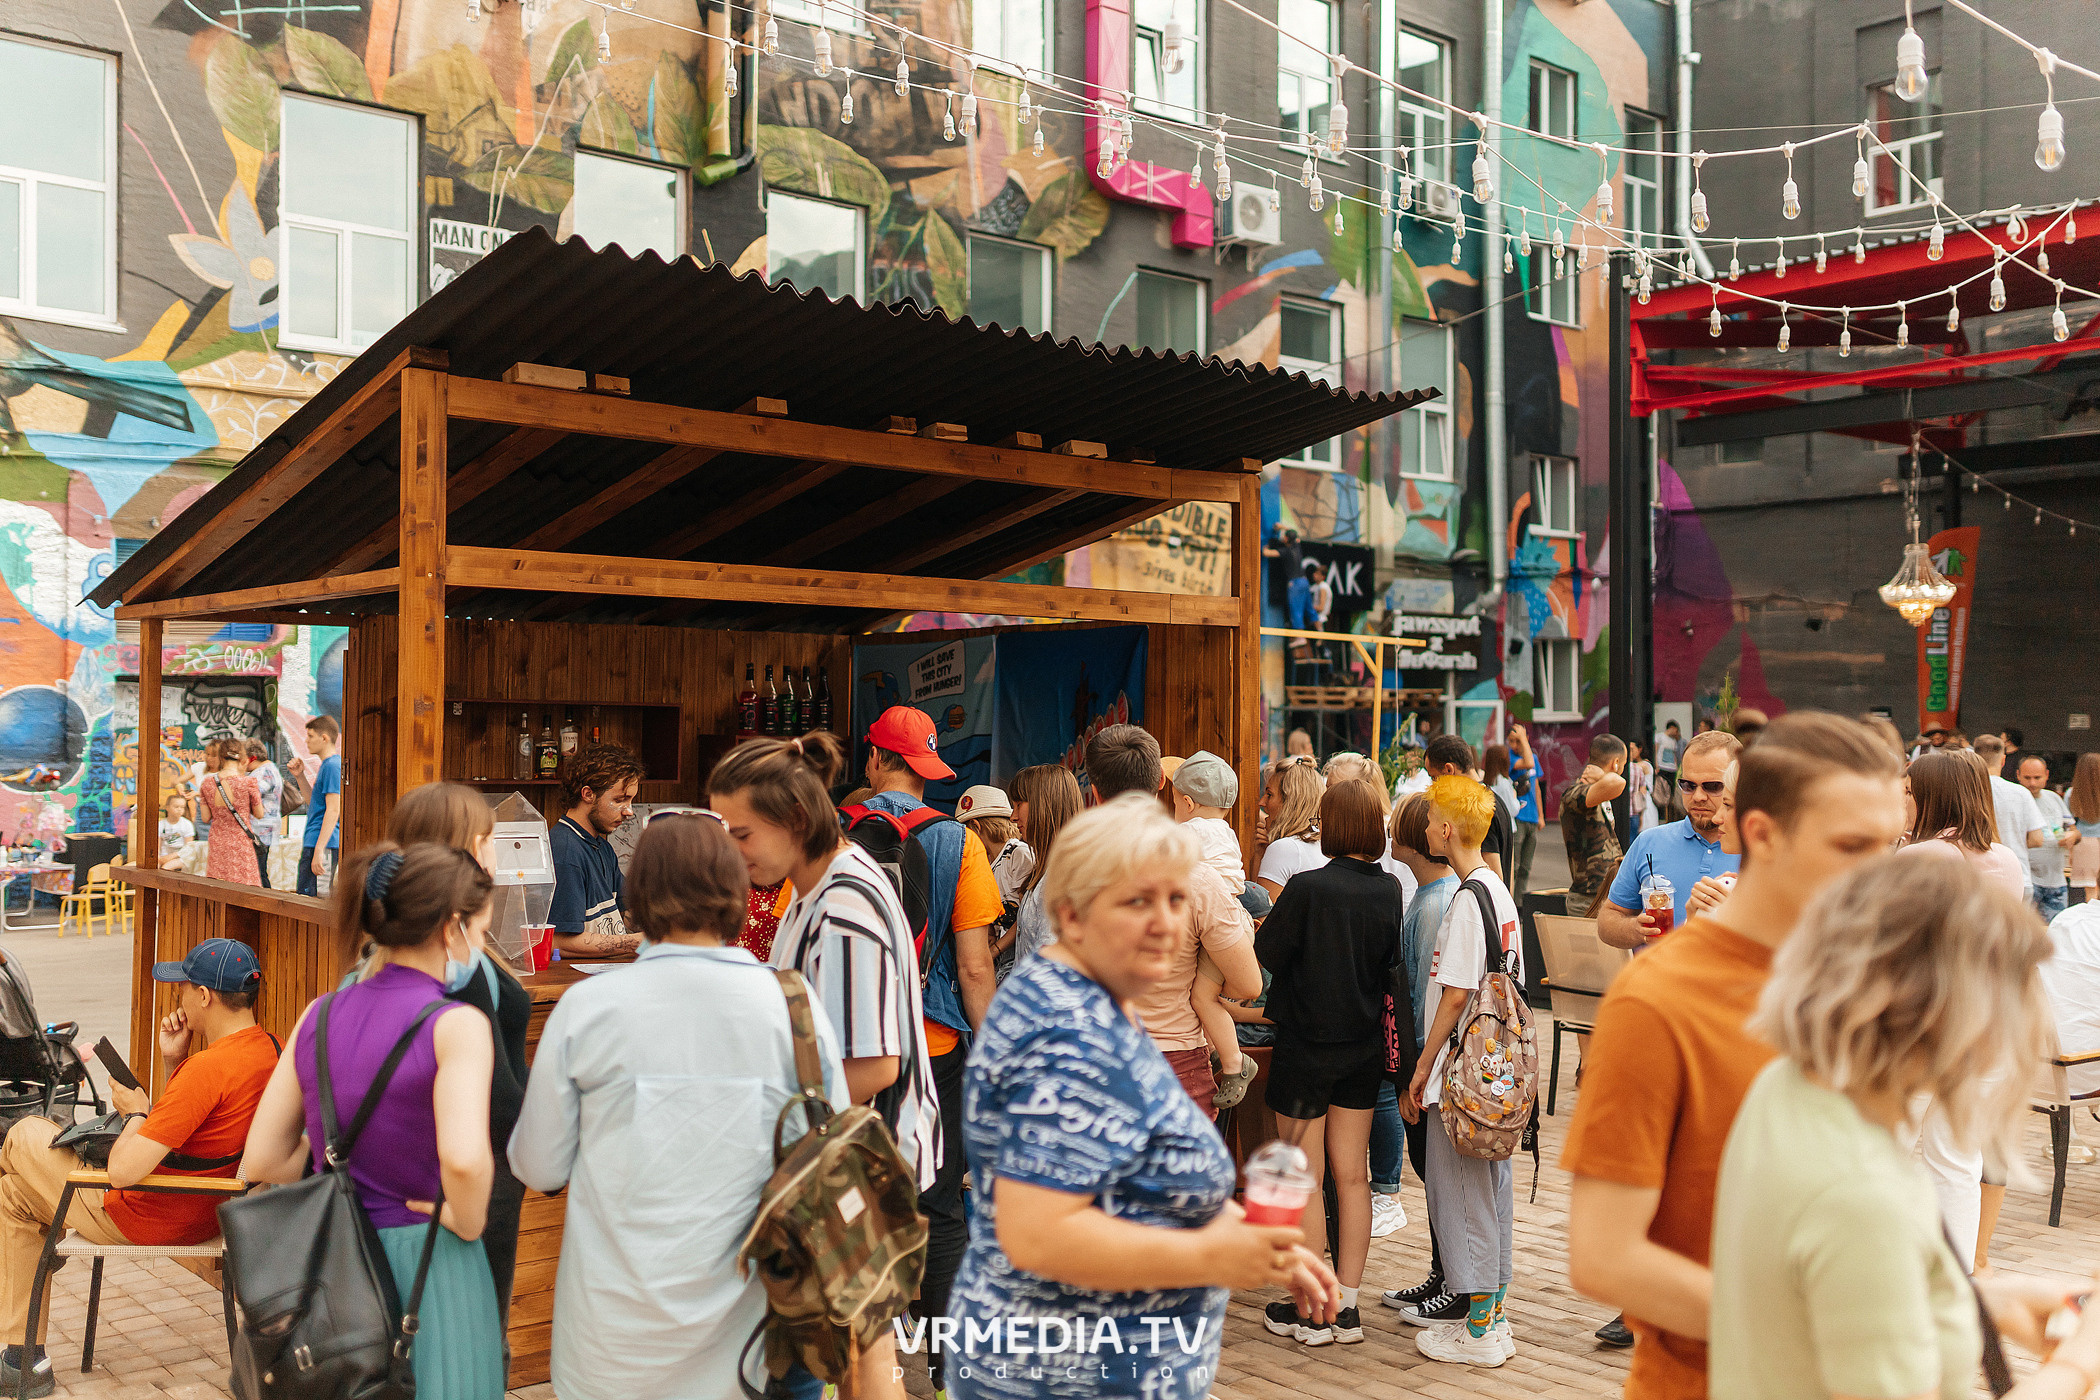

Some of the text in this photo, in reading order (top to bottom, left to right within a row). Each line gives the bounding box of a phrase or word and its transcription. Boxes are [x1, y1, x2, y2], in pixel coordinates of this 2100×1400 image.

[433, 223, 473, 248] MAN
[1162, 501, 1228, 545] DIBLE
[916, 649, 955, 673] I WILL SAVE
[1926, 607, 1950, 712] GoodLine
[922, 664, 952, 683] THIS CITY
[915, 674, 962, 699] FROM HUNGER!
